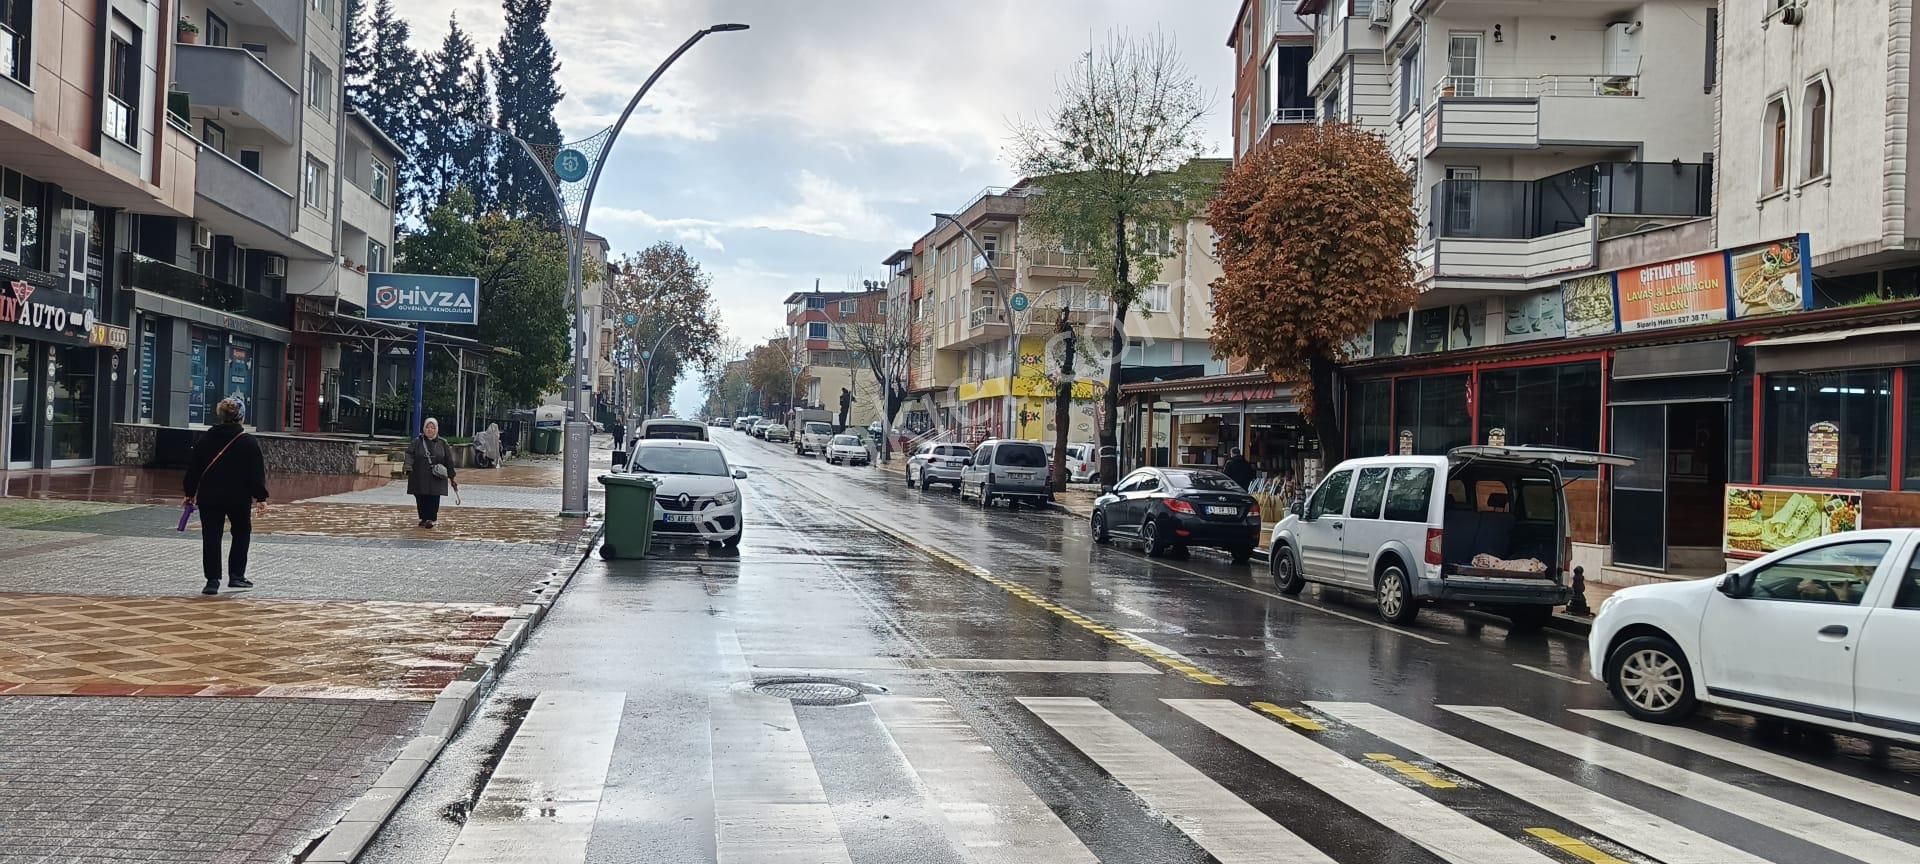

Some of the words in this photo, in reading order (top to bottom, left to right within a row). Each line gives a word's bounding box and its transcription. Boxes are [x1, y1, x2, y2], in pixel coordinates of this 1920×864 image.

[1640, 264, 1673, 284] ÇİFTLİK
[1675, 260, 1696, 276] PİDE
[398, 285, 472, 308] HİVZA
[1656, 287, 1662, 297] &
[1665, 279, 1719, 296] LAHMACUN
[398, 304, 428, 312] GÜVENLİK
[430, 306, 473, 314] TEKNOLOJİLERİ
[1653, 298, 1690, 313] SALONU
[18, 300, 66, 332] AUTO
[1636, 319, 1657, 329] Sipariş
[1678, 315, 1690, 323] 527
